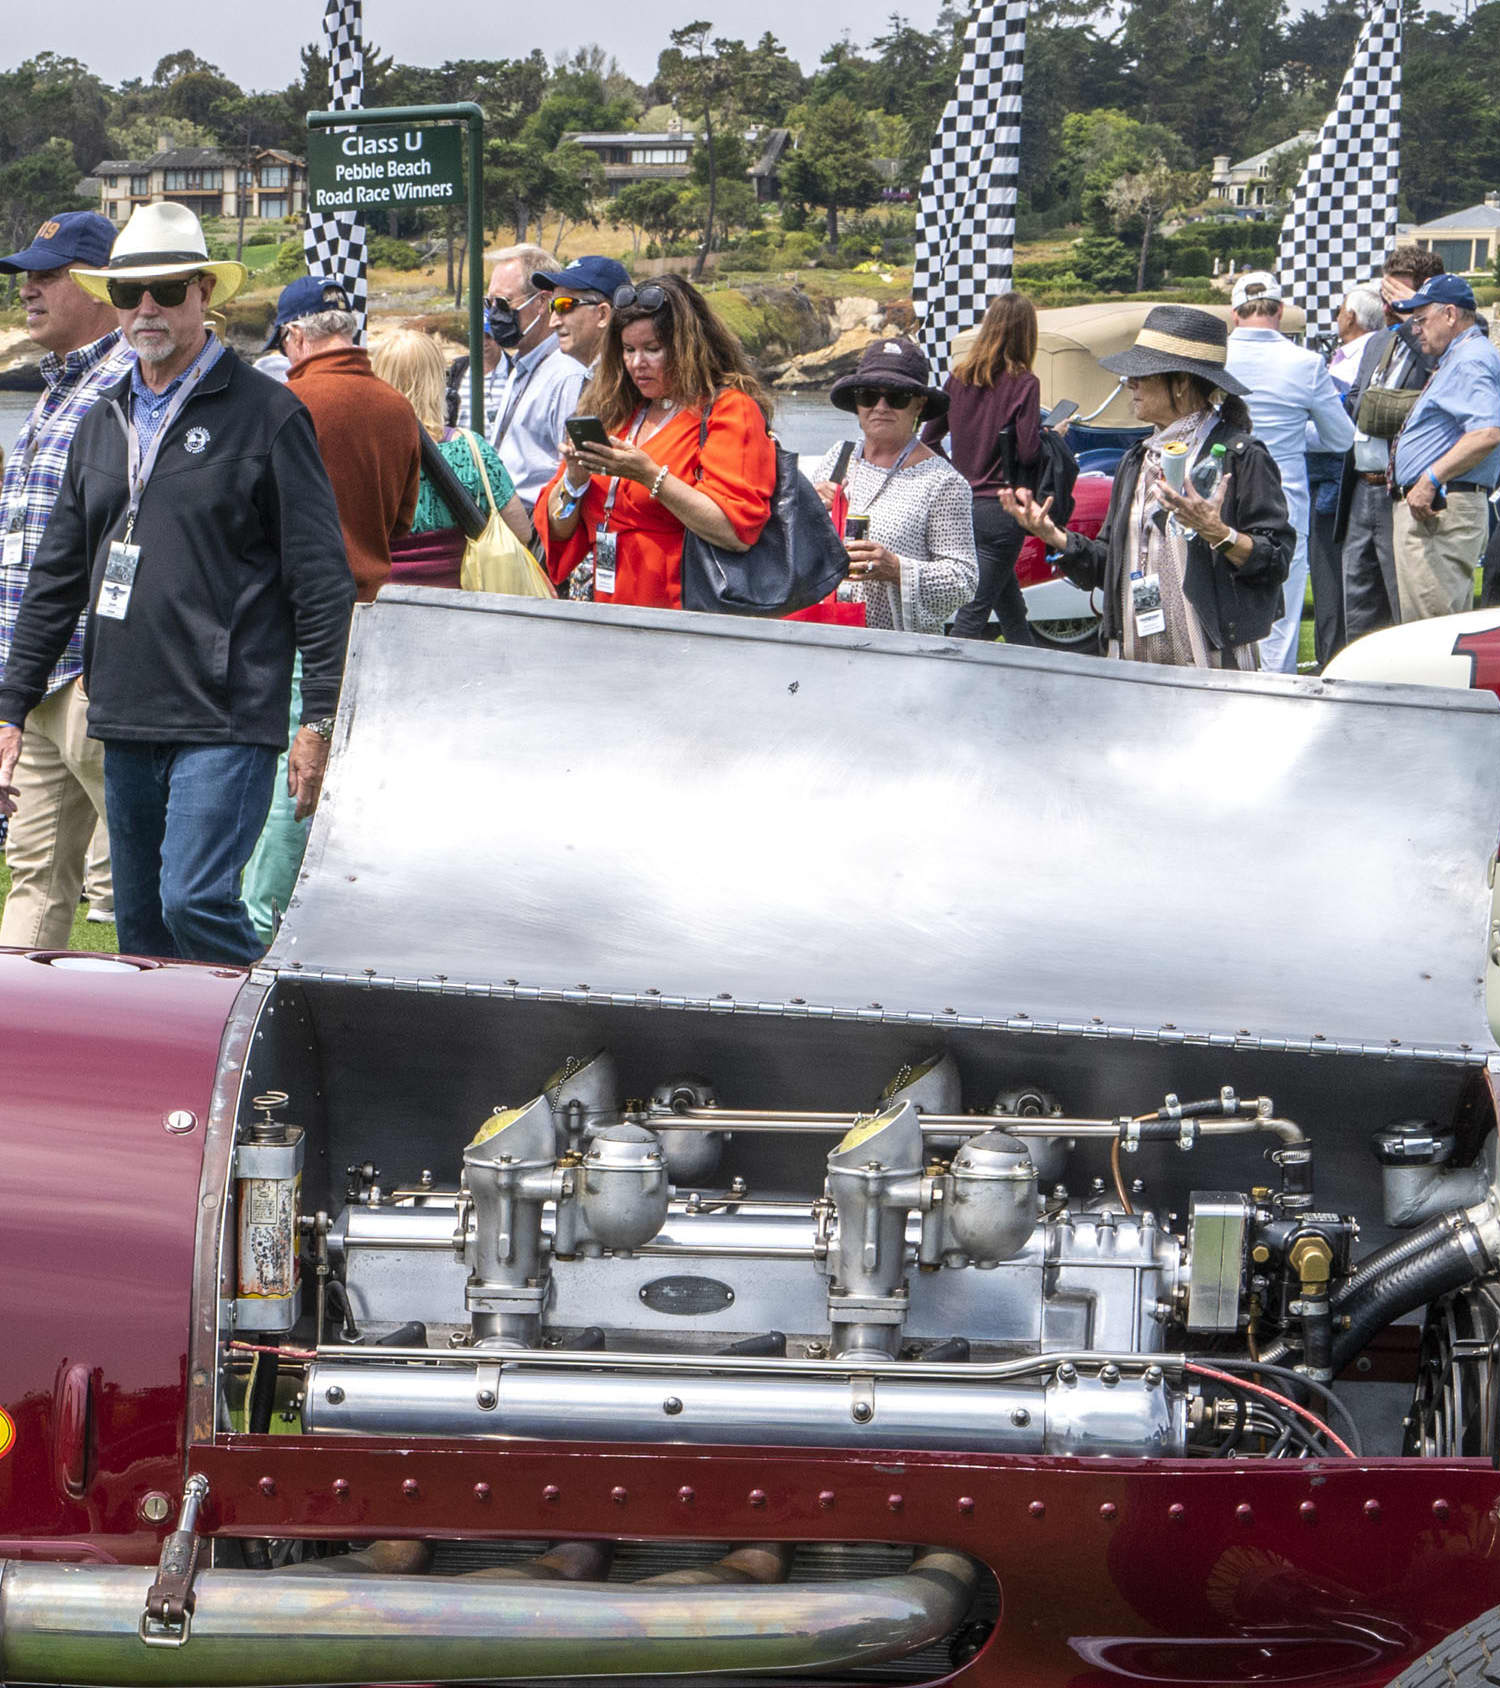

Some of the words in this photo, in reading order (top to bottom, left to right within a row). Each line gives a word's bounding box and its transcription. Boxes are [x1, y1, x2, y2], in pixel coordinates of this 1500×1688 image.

[342, 136, 398, 156] Class
[404, 131, 423, 151] U
[335, 161, 384, 181] Pebble
[387, 157, 432, 178] Beach
[316, 187, 353, 206] Road
[355, 185, 390, 203] Race
[392, 182, 453, 201] Winners
